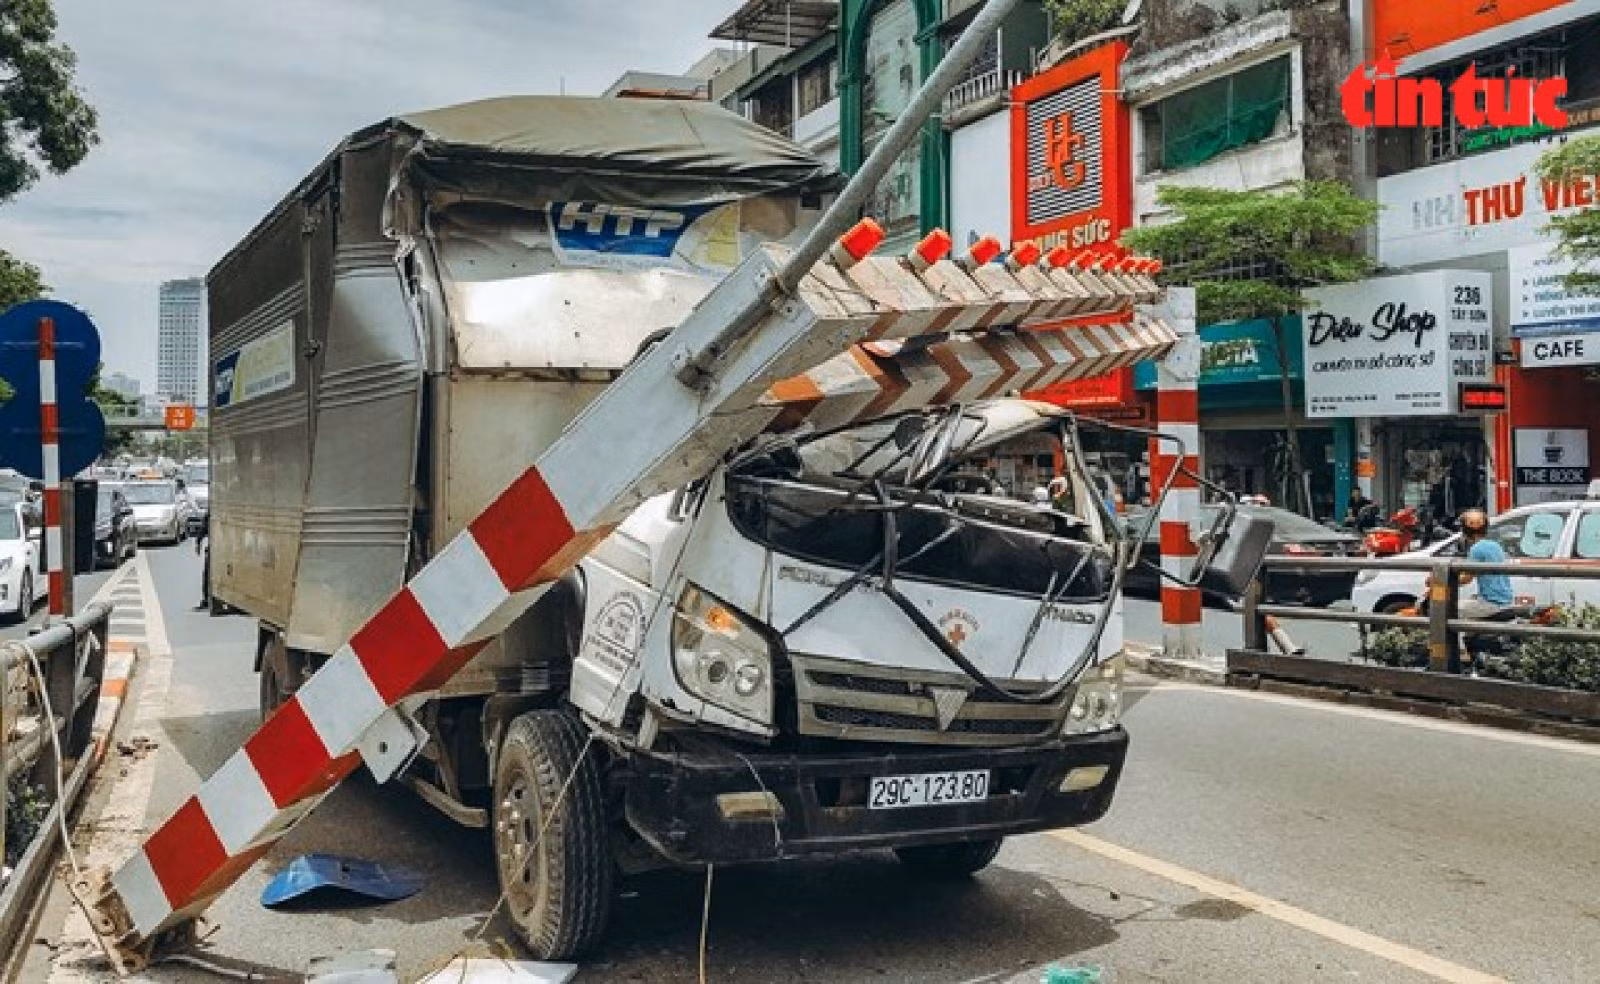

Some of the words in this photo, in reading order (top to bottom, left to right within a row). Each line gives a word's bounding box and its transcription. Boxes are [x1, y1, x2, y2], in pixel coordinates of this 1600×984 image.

[1464, 171, 1528, 226] THƯ
[558, 201, 684, 238] HTP
[1368, 301, 1436, 347] Shop
[1534, 339, 1584, 360] CAFE
[1522, 468, 1546, 483] THE
